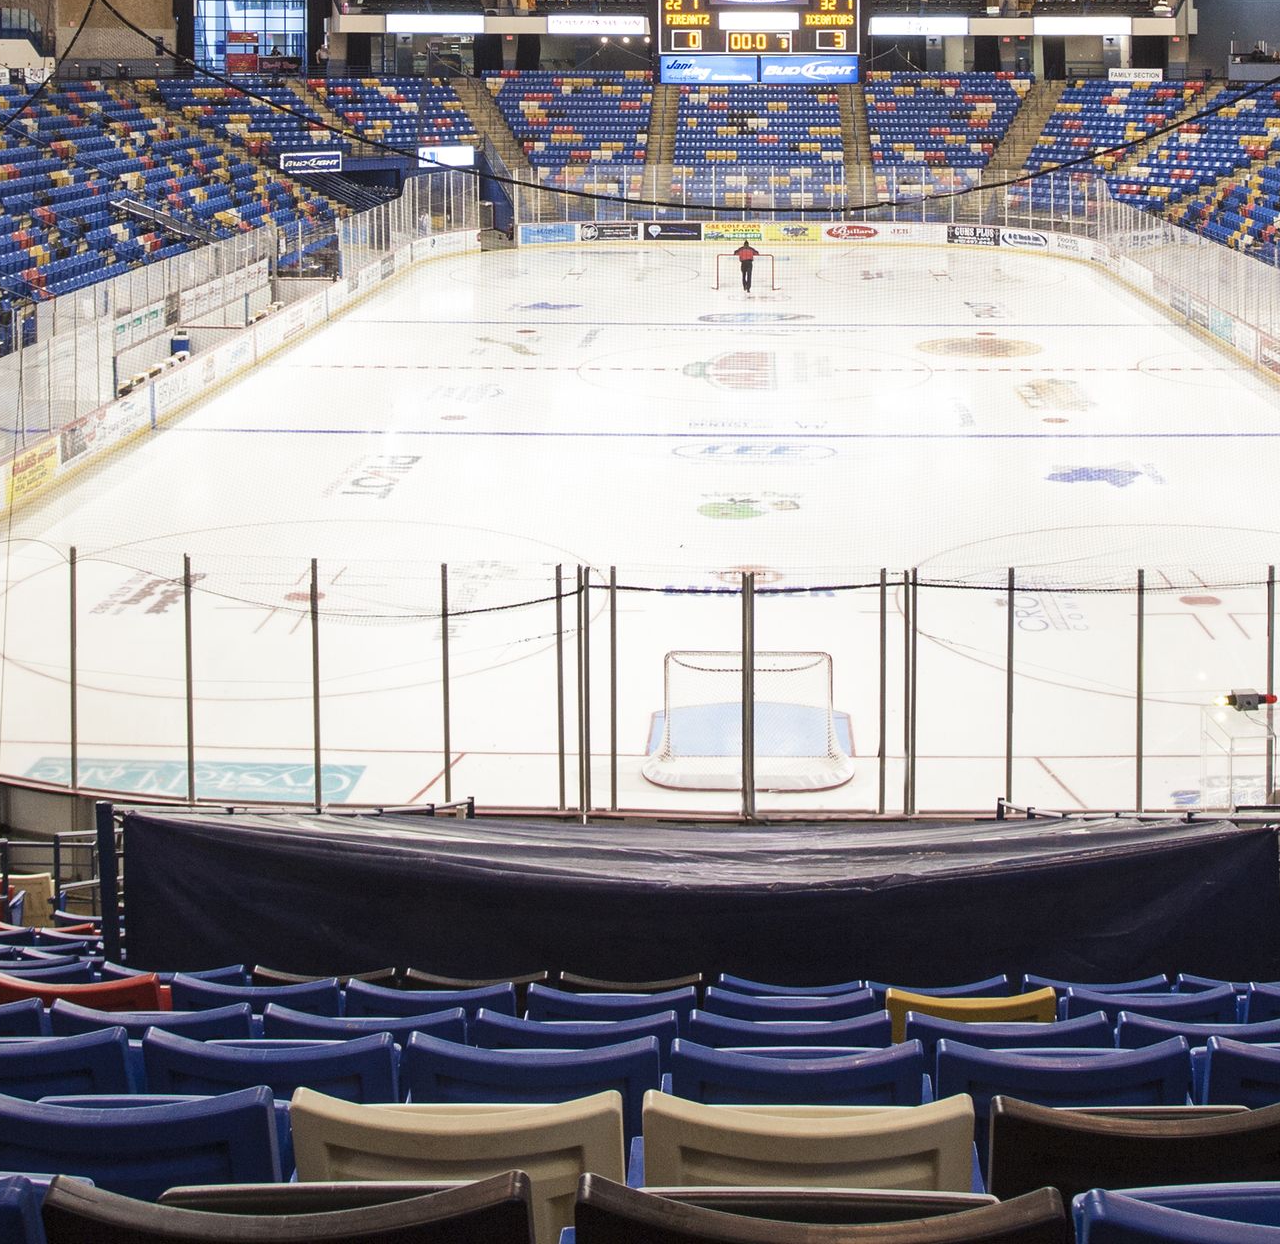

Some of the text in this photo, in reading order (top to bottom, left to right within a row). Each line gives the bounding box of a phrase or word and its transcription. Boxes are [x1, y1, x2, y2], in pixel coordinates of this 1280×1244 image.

[666, 14, 710, 25] FIREANTZ
[805, 14, 854, 25] ICEGATORS
[689, 32, 699, 48] 0
[730, 33, 767, 50] 00.0
[834, 33, 844, 48] 3
[954, 227, 994, 237] GUNS PLUS
